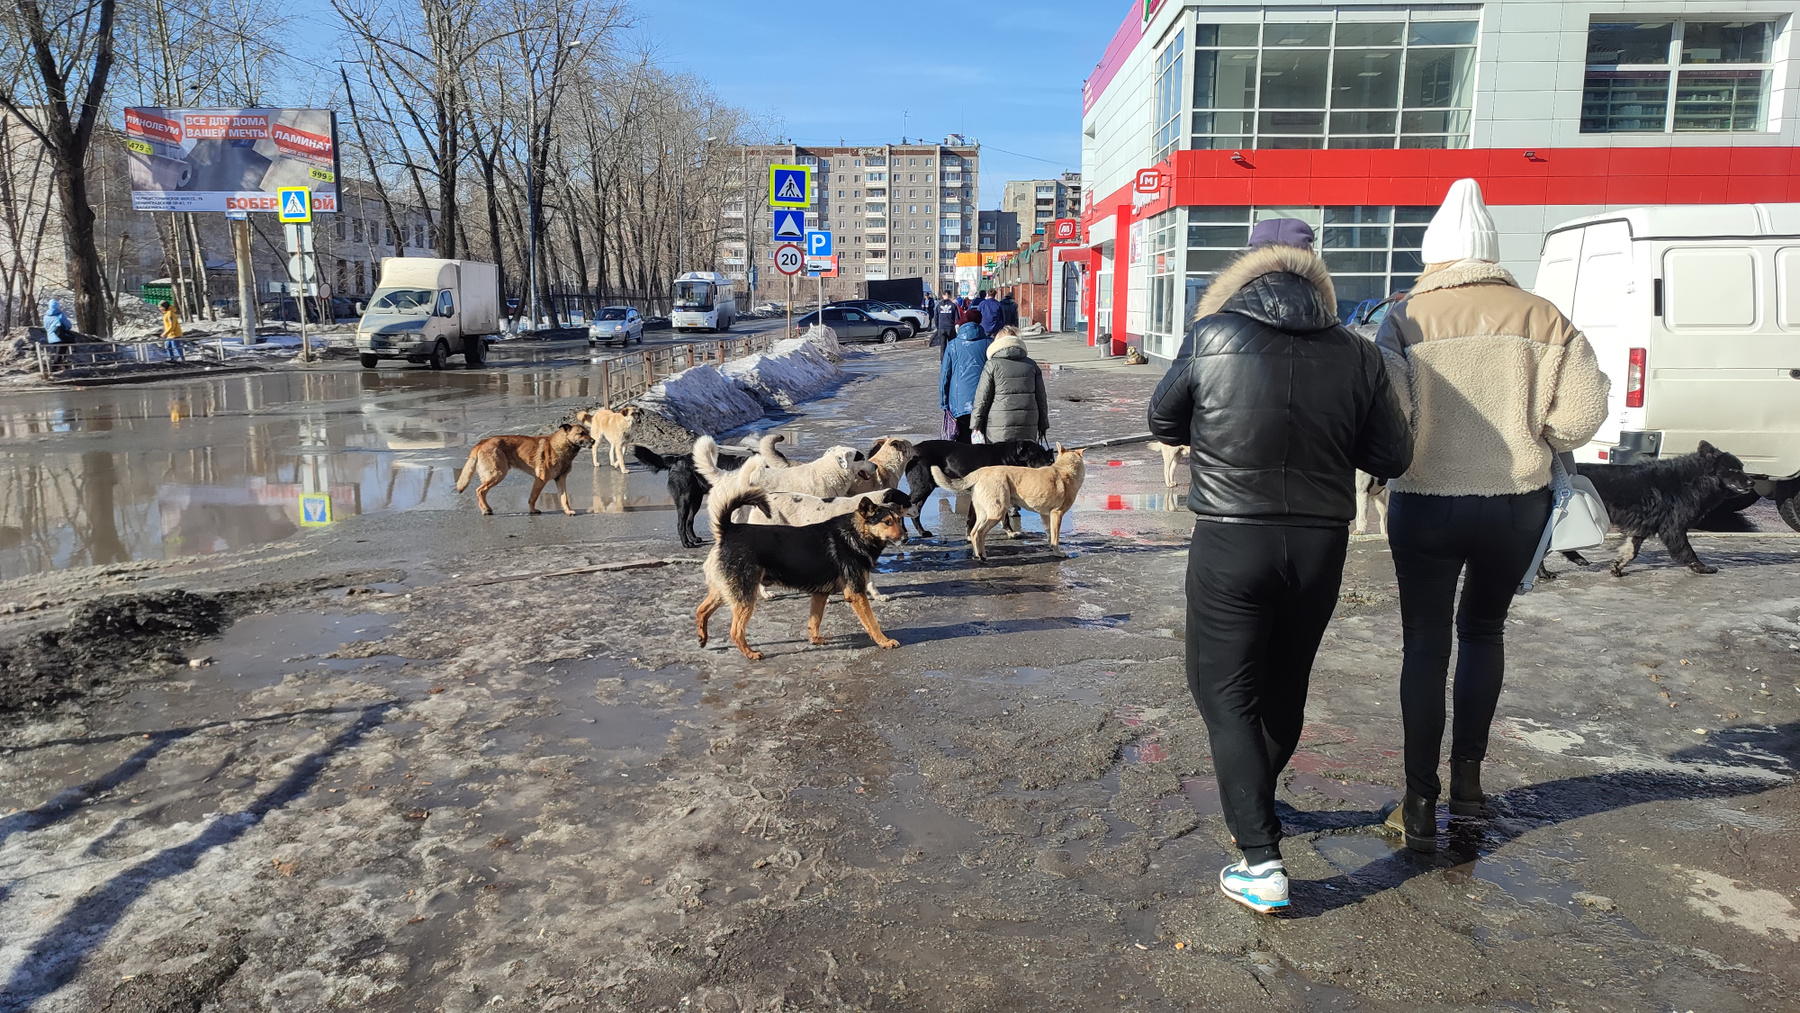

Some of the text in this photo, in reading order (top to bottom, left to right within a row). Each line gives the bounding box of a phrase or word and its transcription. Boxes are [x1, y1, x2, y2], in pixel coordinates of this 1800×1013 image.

[126, 115, 180, 136] ЛИНОЛЕУМ
[185, 116, 267, 126] ВСЕ ДЛЯ ДОМА
[186, 127, 226, 137] ВАШЕЙ
[229, 128, 268, 138] МЕЧТЫ
[129, 142, 145, 151] 479
[274, 130, 332, 152] ЛАМИНАТ
[311, 170, 327, 180] 999
[811, 234, 826, 255] P
[781, 253, 798, 266] 20
